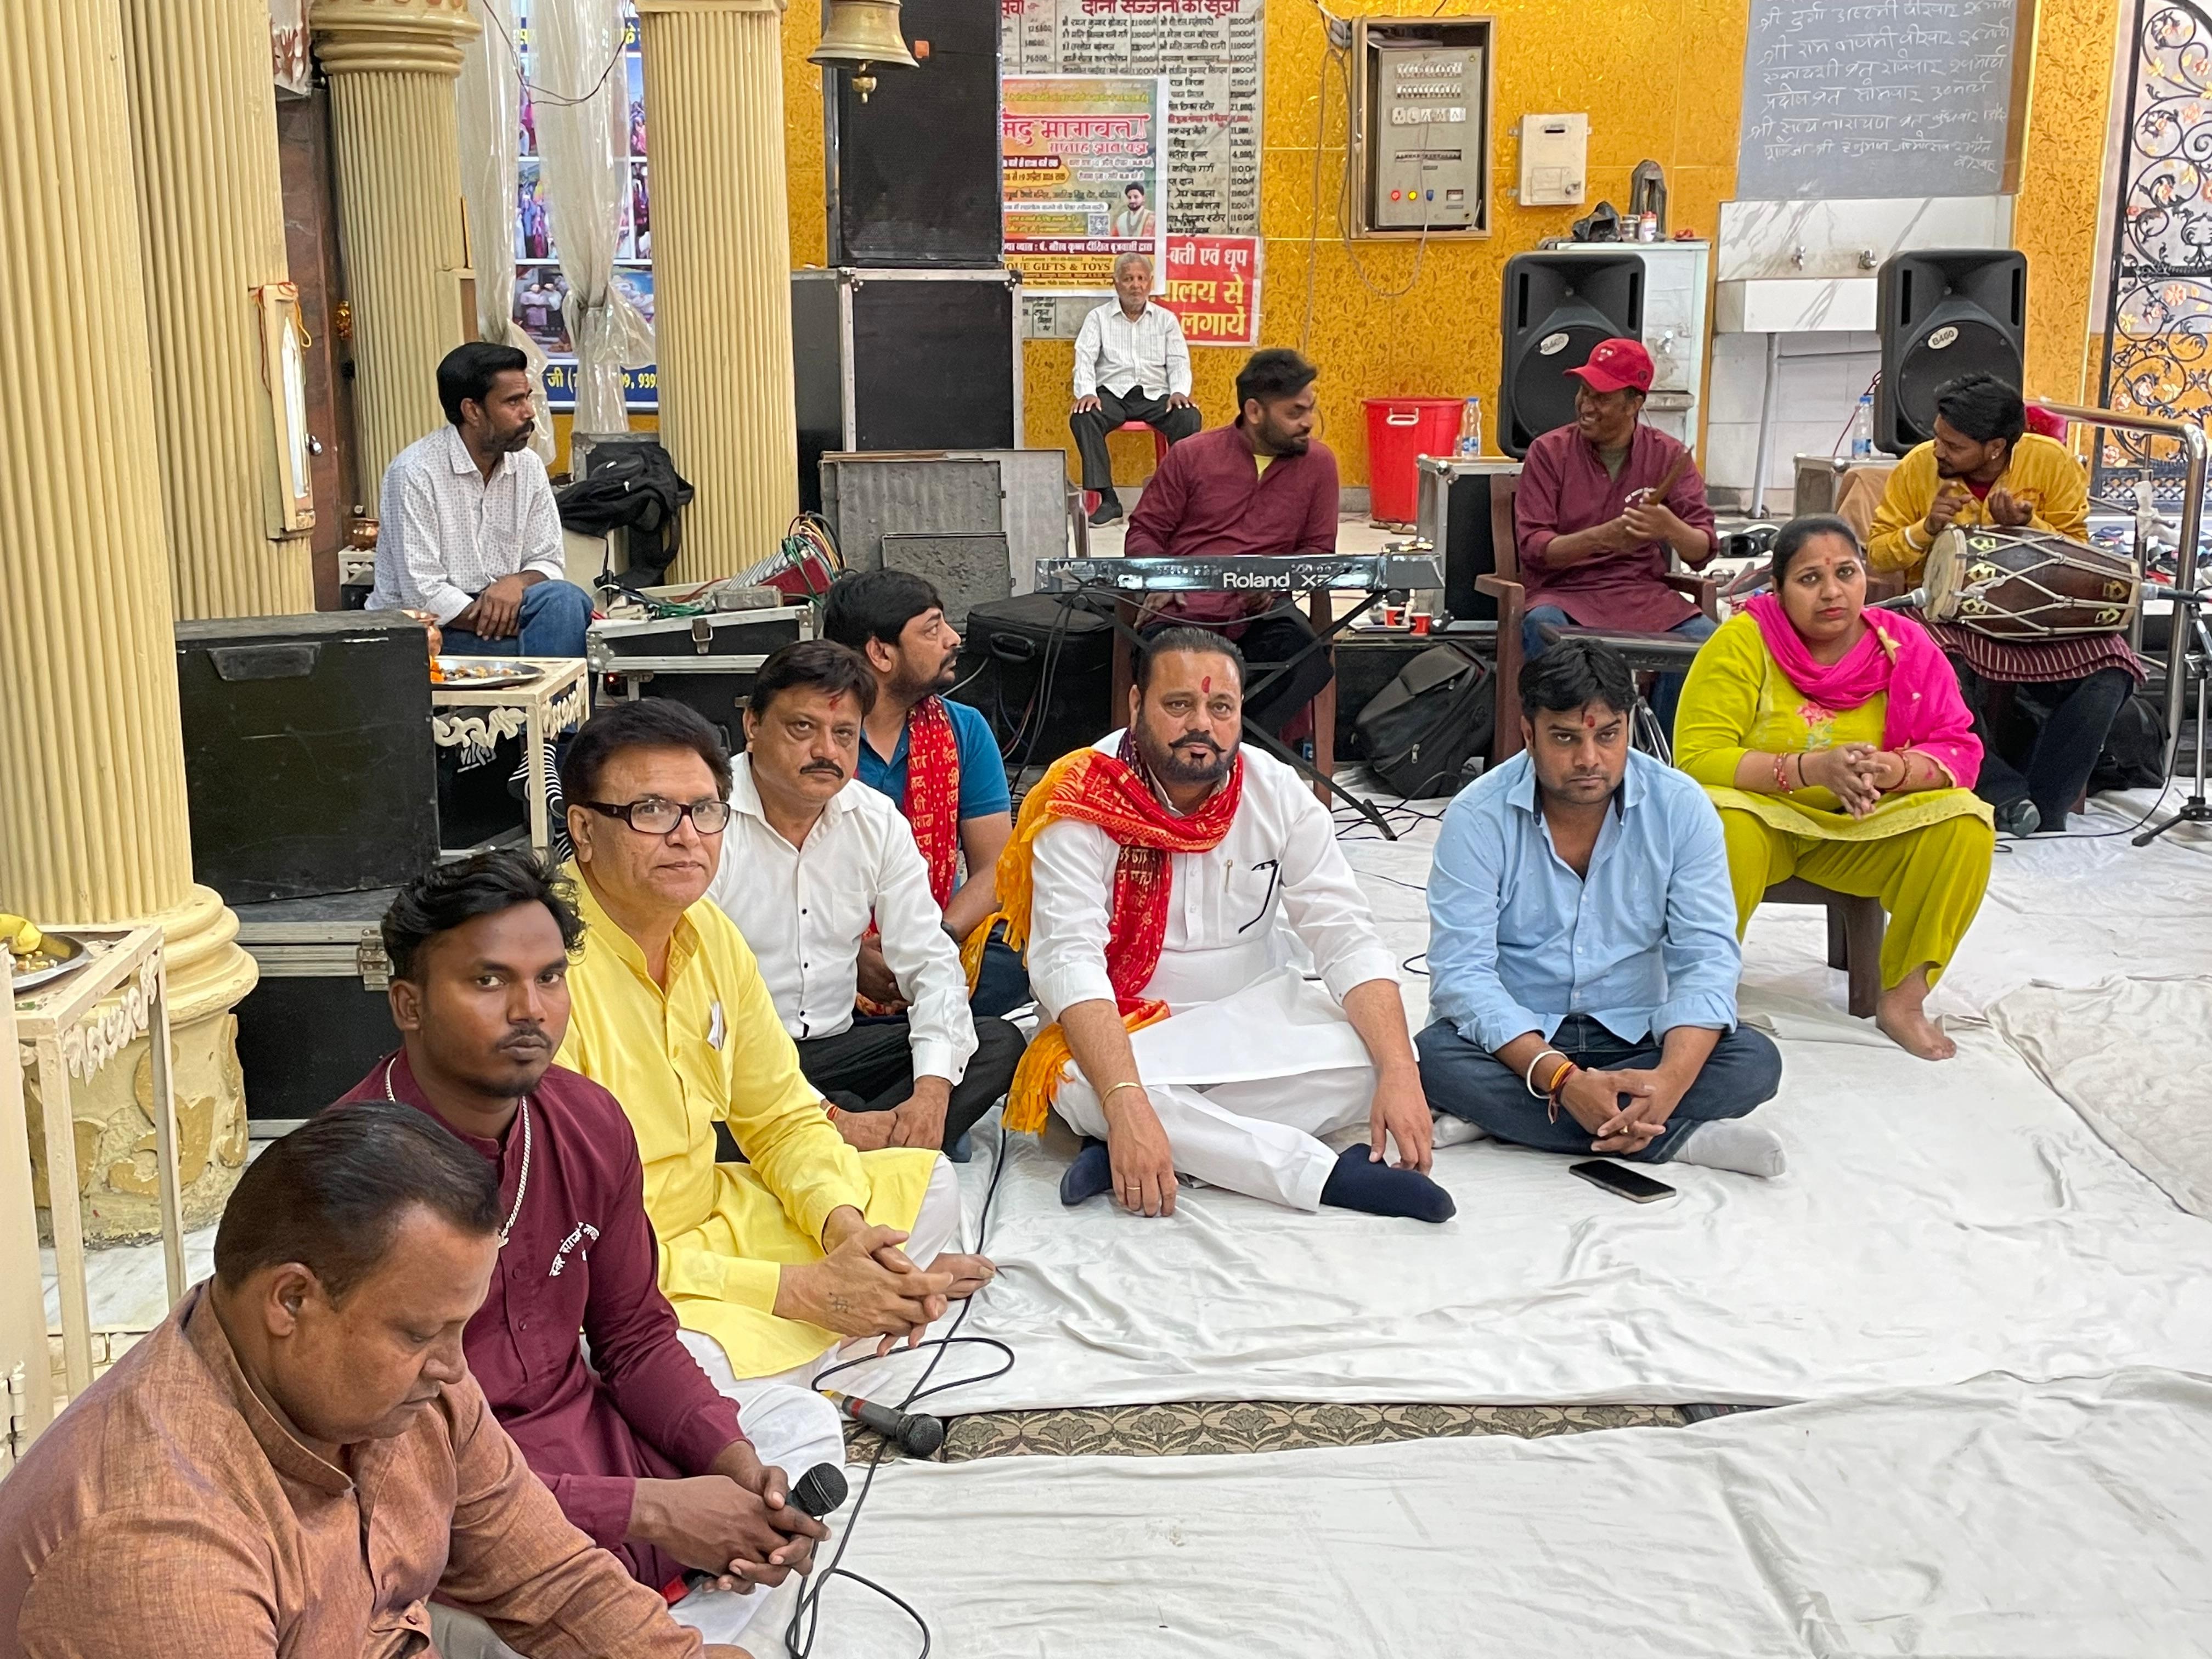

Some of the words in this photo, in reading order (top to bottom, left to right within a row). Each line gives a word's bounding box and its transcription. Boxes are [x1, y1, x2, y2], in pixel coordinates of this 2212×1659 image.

[1033, 262, 1066, 270] GIFTS
[1082, 262, 1110, 270] TOYS
[1224, 249, 1248, 273] धूप
[1223, 273, 1244, 304] से
[1223, 572, 1290, 588] Roland
